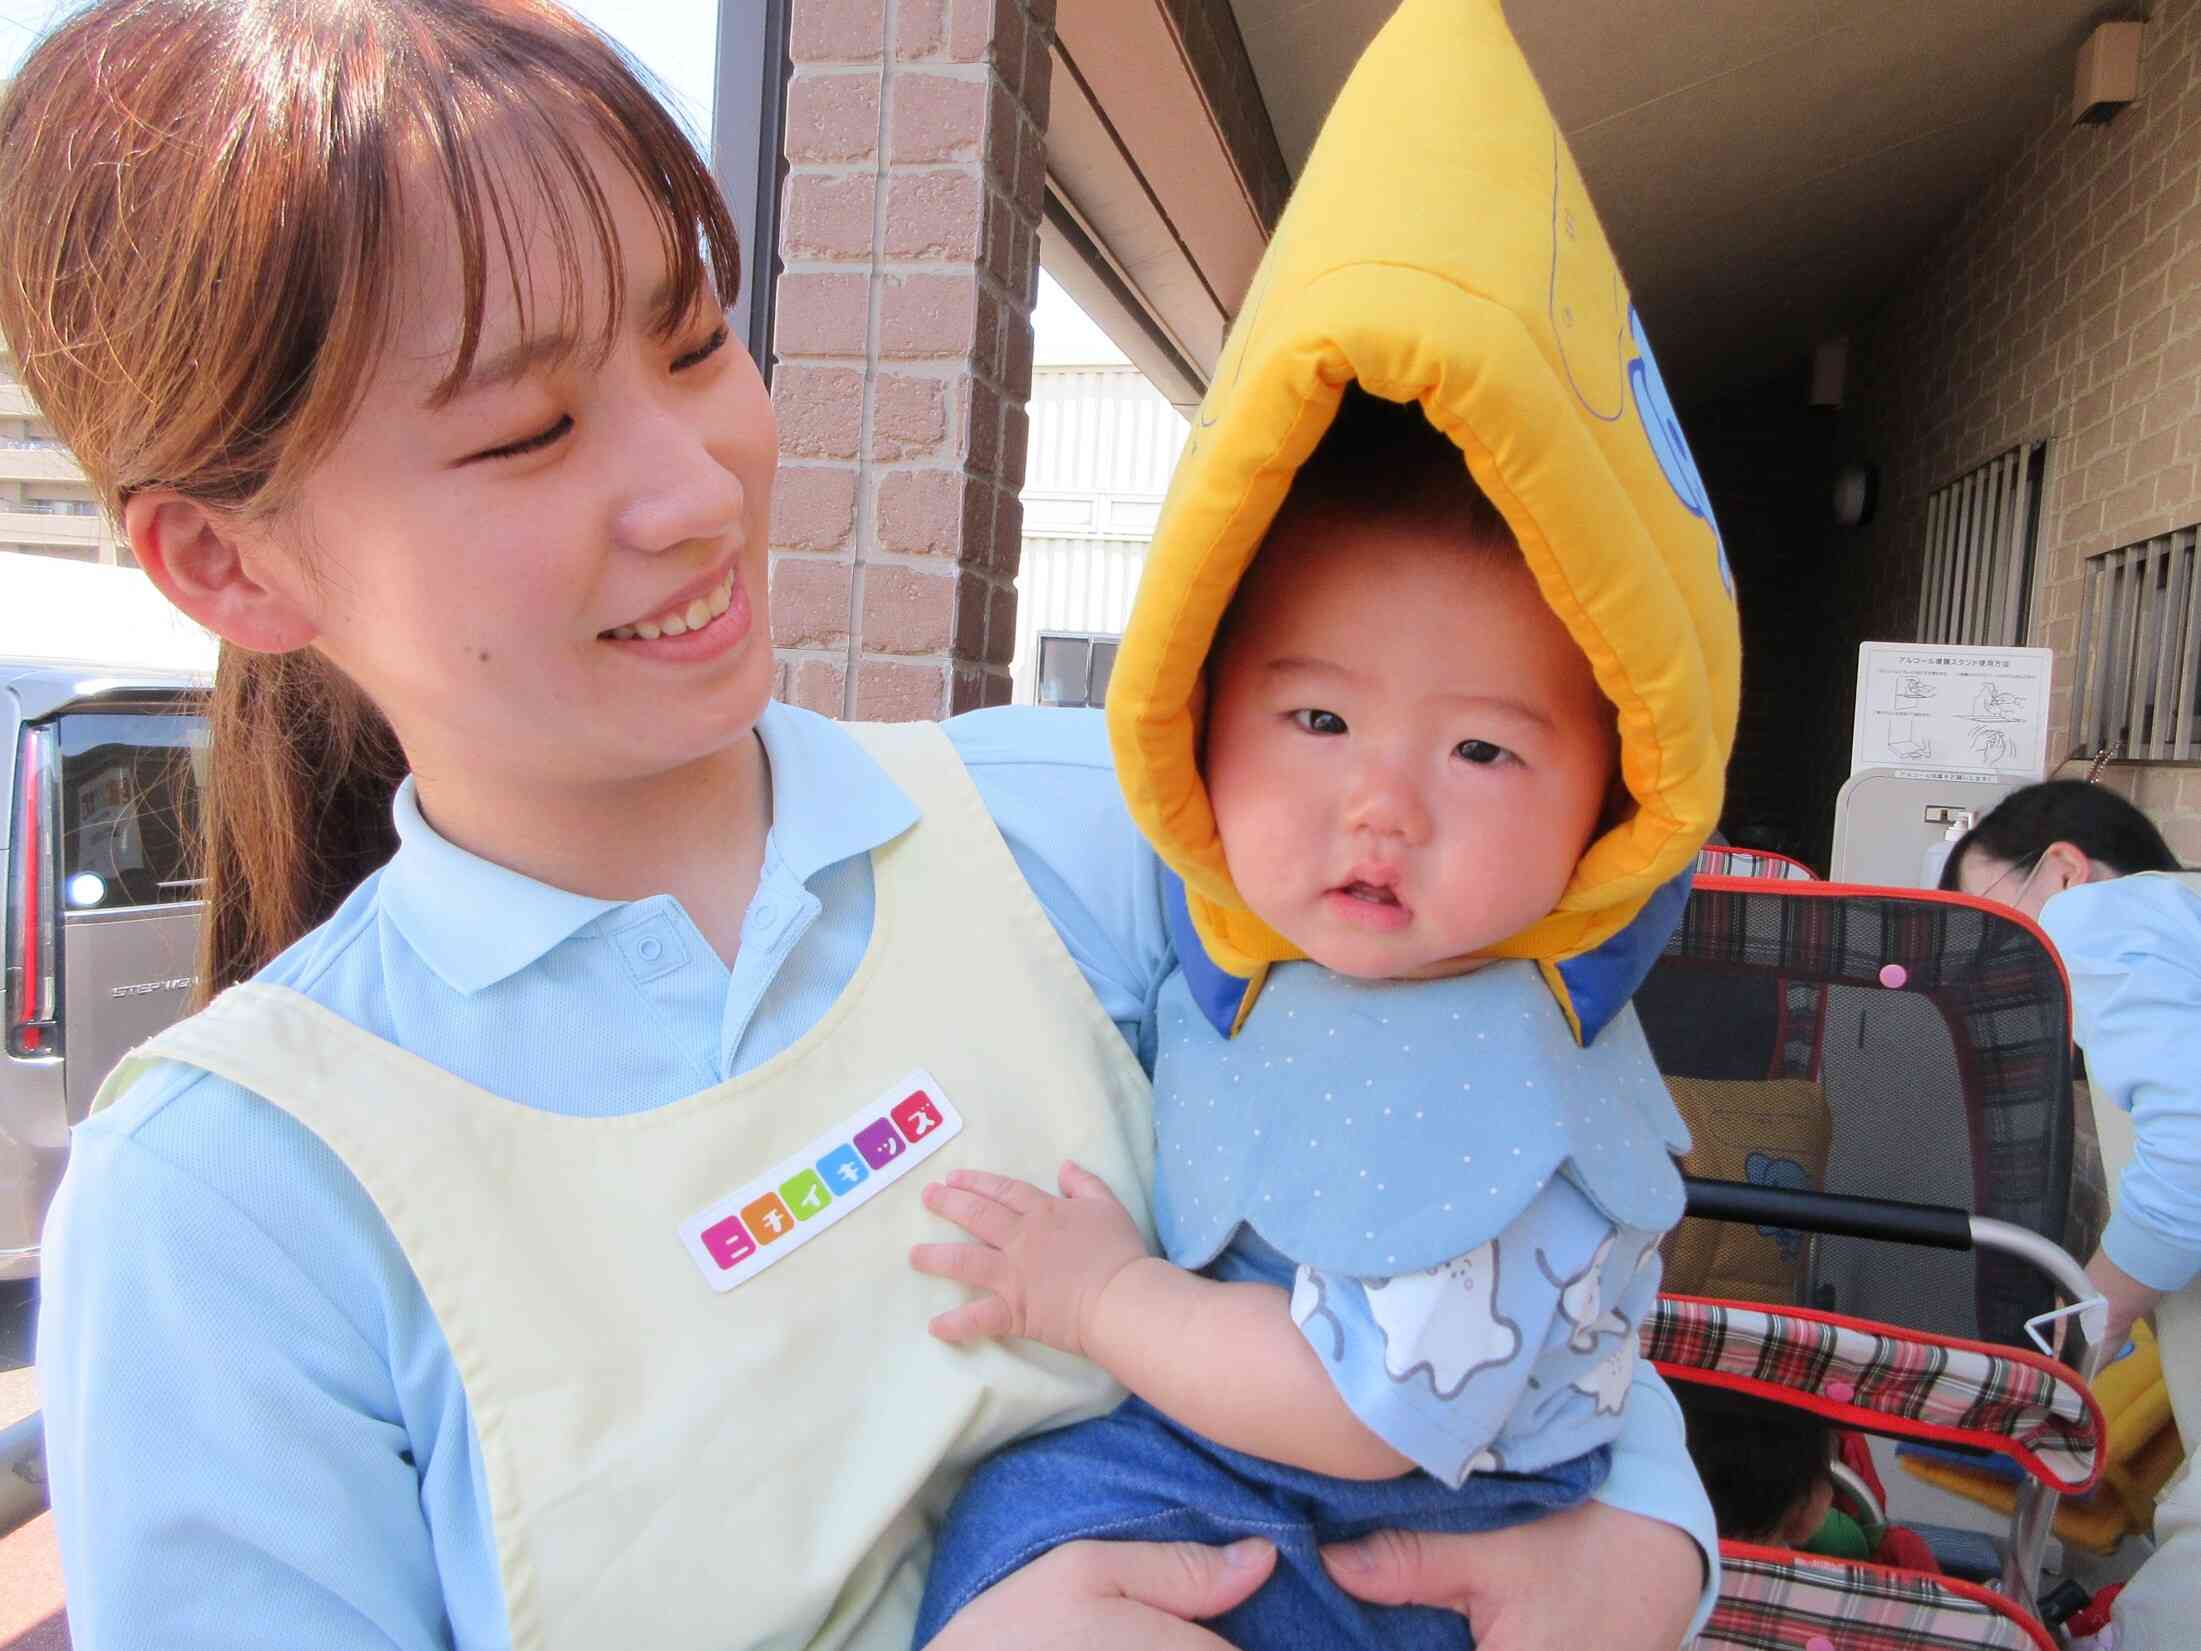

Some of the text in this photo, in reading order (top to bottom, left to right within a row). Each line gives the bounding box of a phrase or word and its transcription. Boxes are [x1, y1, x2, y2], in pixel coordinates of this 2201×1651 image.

[721, 1097, 939, 1261] ニチイキッズ
